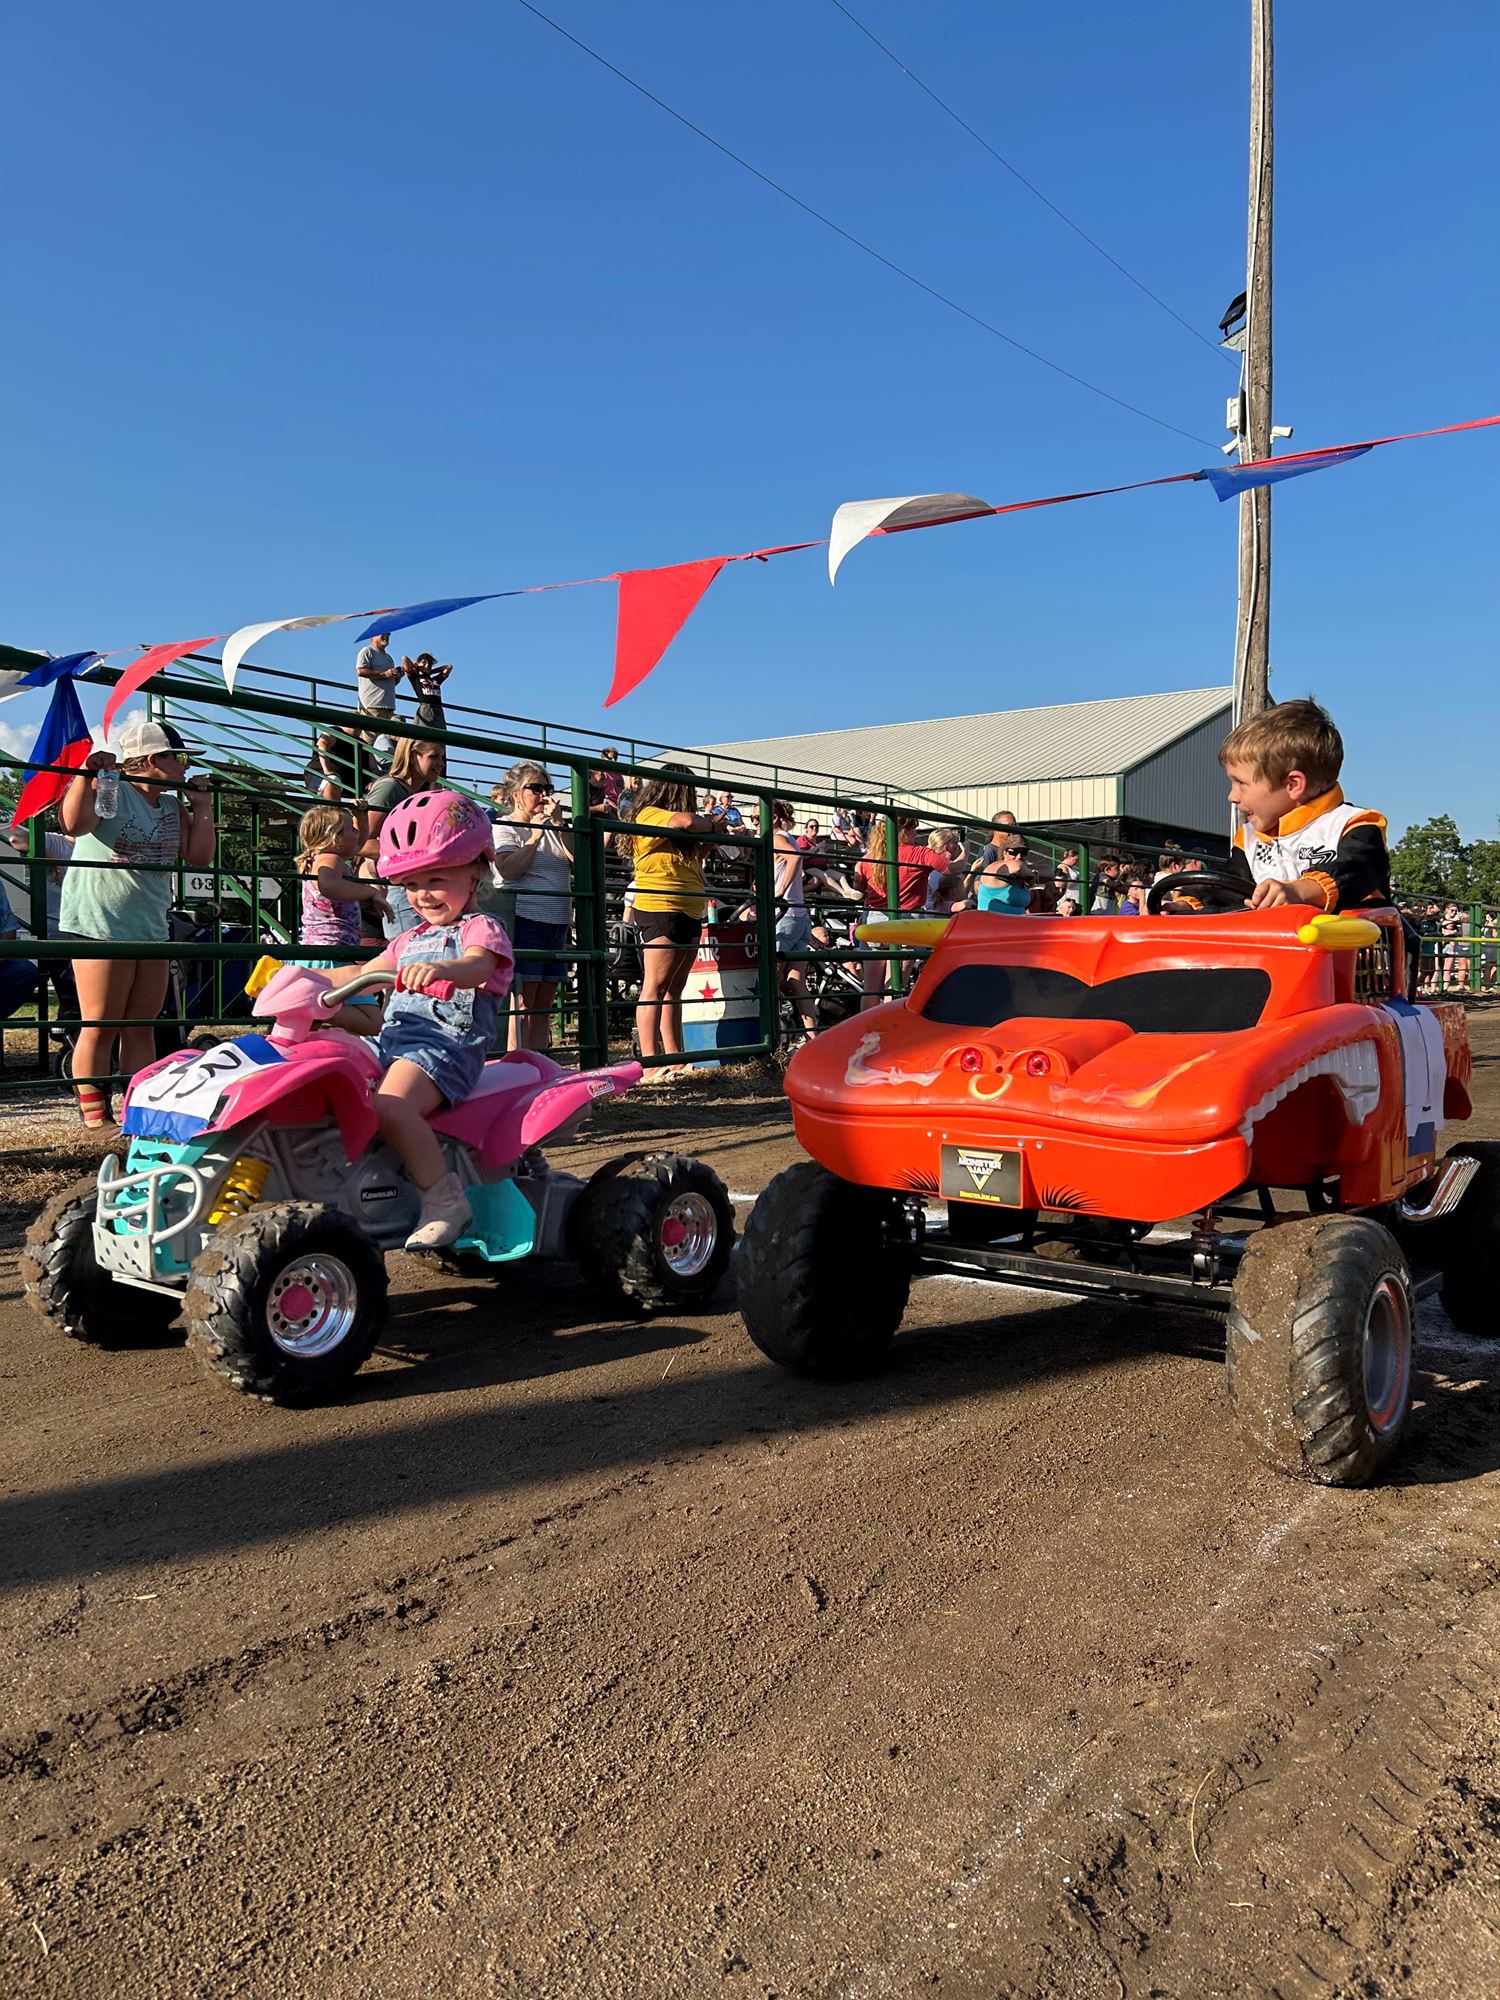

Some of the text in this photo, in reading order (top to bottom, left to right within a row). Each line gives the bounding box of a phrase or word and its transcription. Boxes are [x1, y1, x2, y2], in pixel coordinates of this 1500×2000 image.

[958, 1157, 1002, 1170] MONSTER
[971, 1165, 992, 1175] JAM
[362, 1189, 397, 1200] Kawasaki
